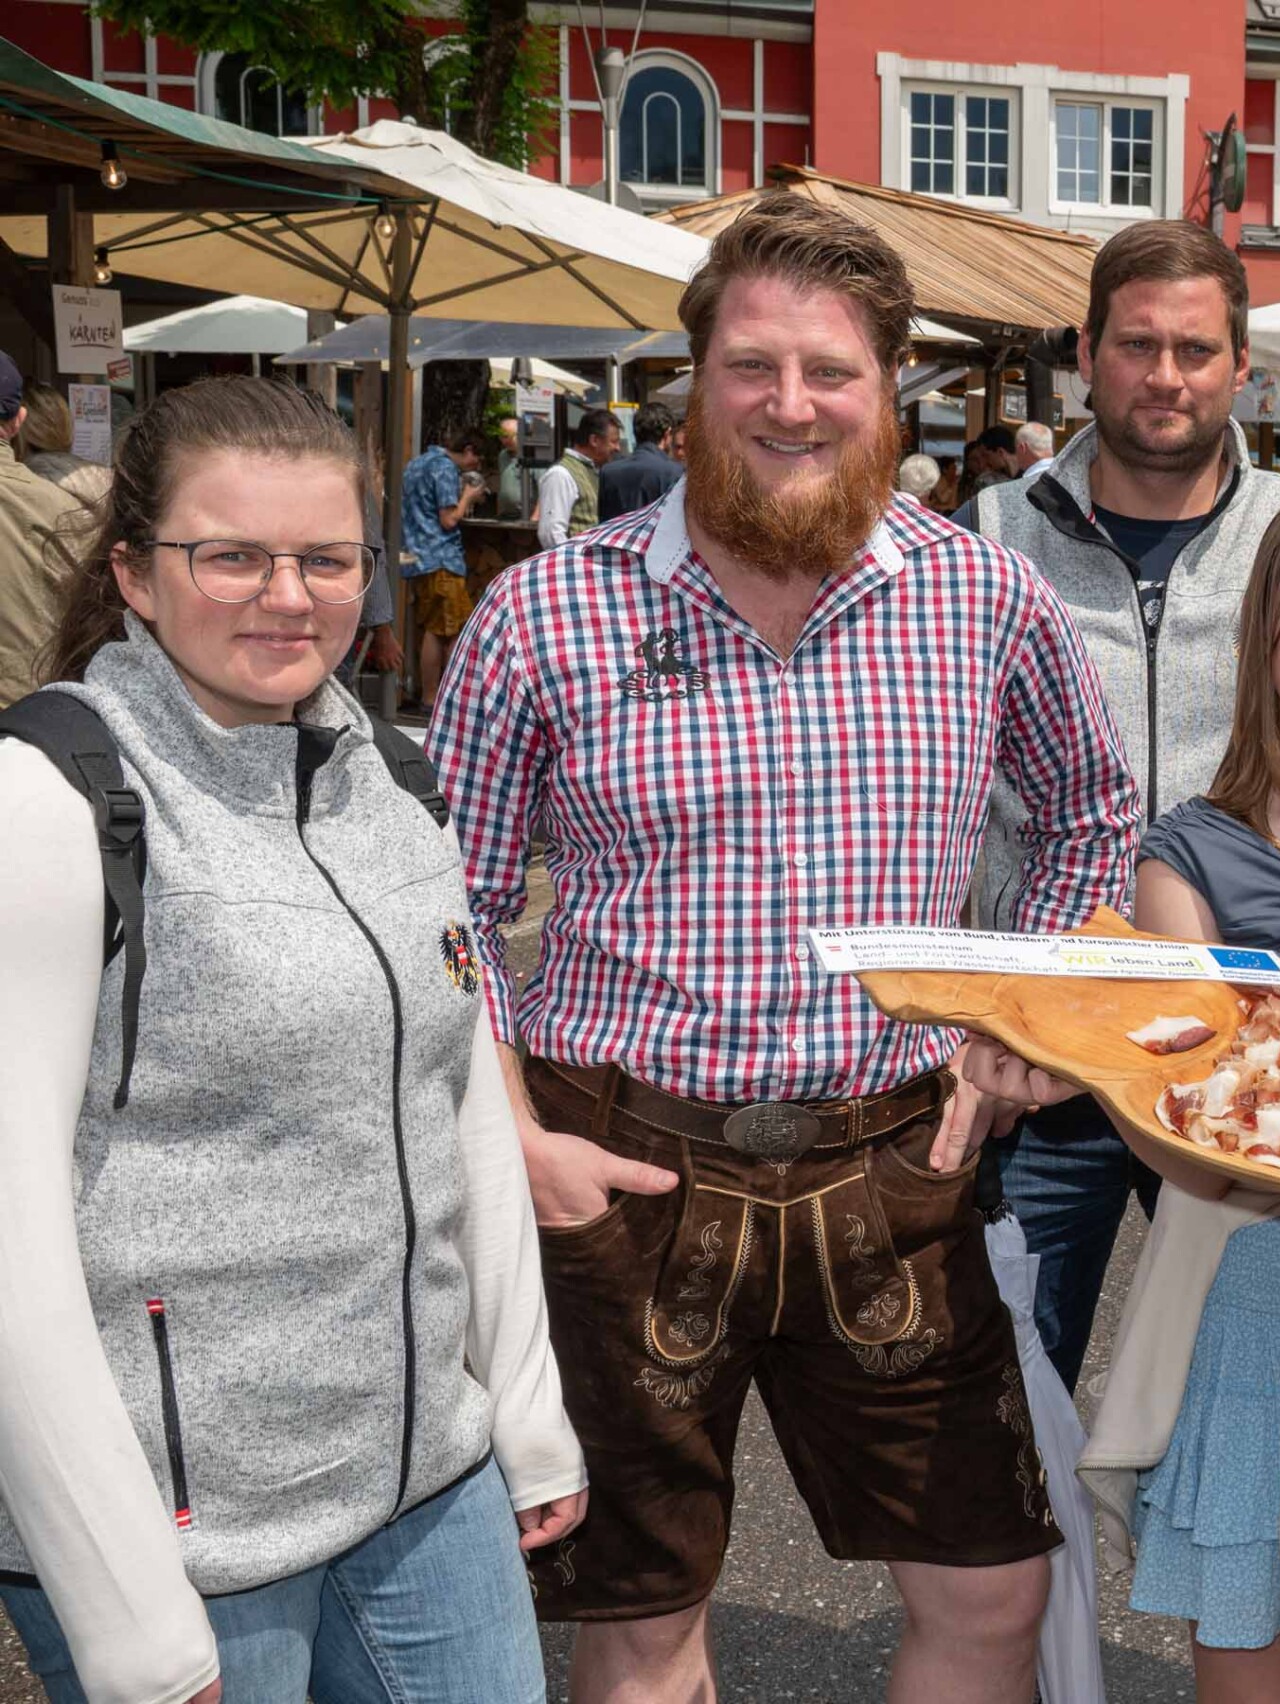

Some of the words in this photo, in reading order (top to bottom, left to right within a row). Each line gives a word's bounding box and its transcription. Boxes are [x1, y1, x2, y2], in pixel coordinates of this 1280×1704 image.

[845, 928, 936, 937] Unterstützung
[963, 931, 999, 941] Bund,
[1001, 934, 1050, 943] Ländern
[1078, 937, 1152, 948] Europäischer
[1154, 942, 1190, 951] Union
[1157, 958, 1196, 969] Land
